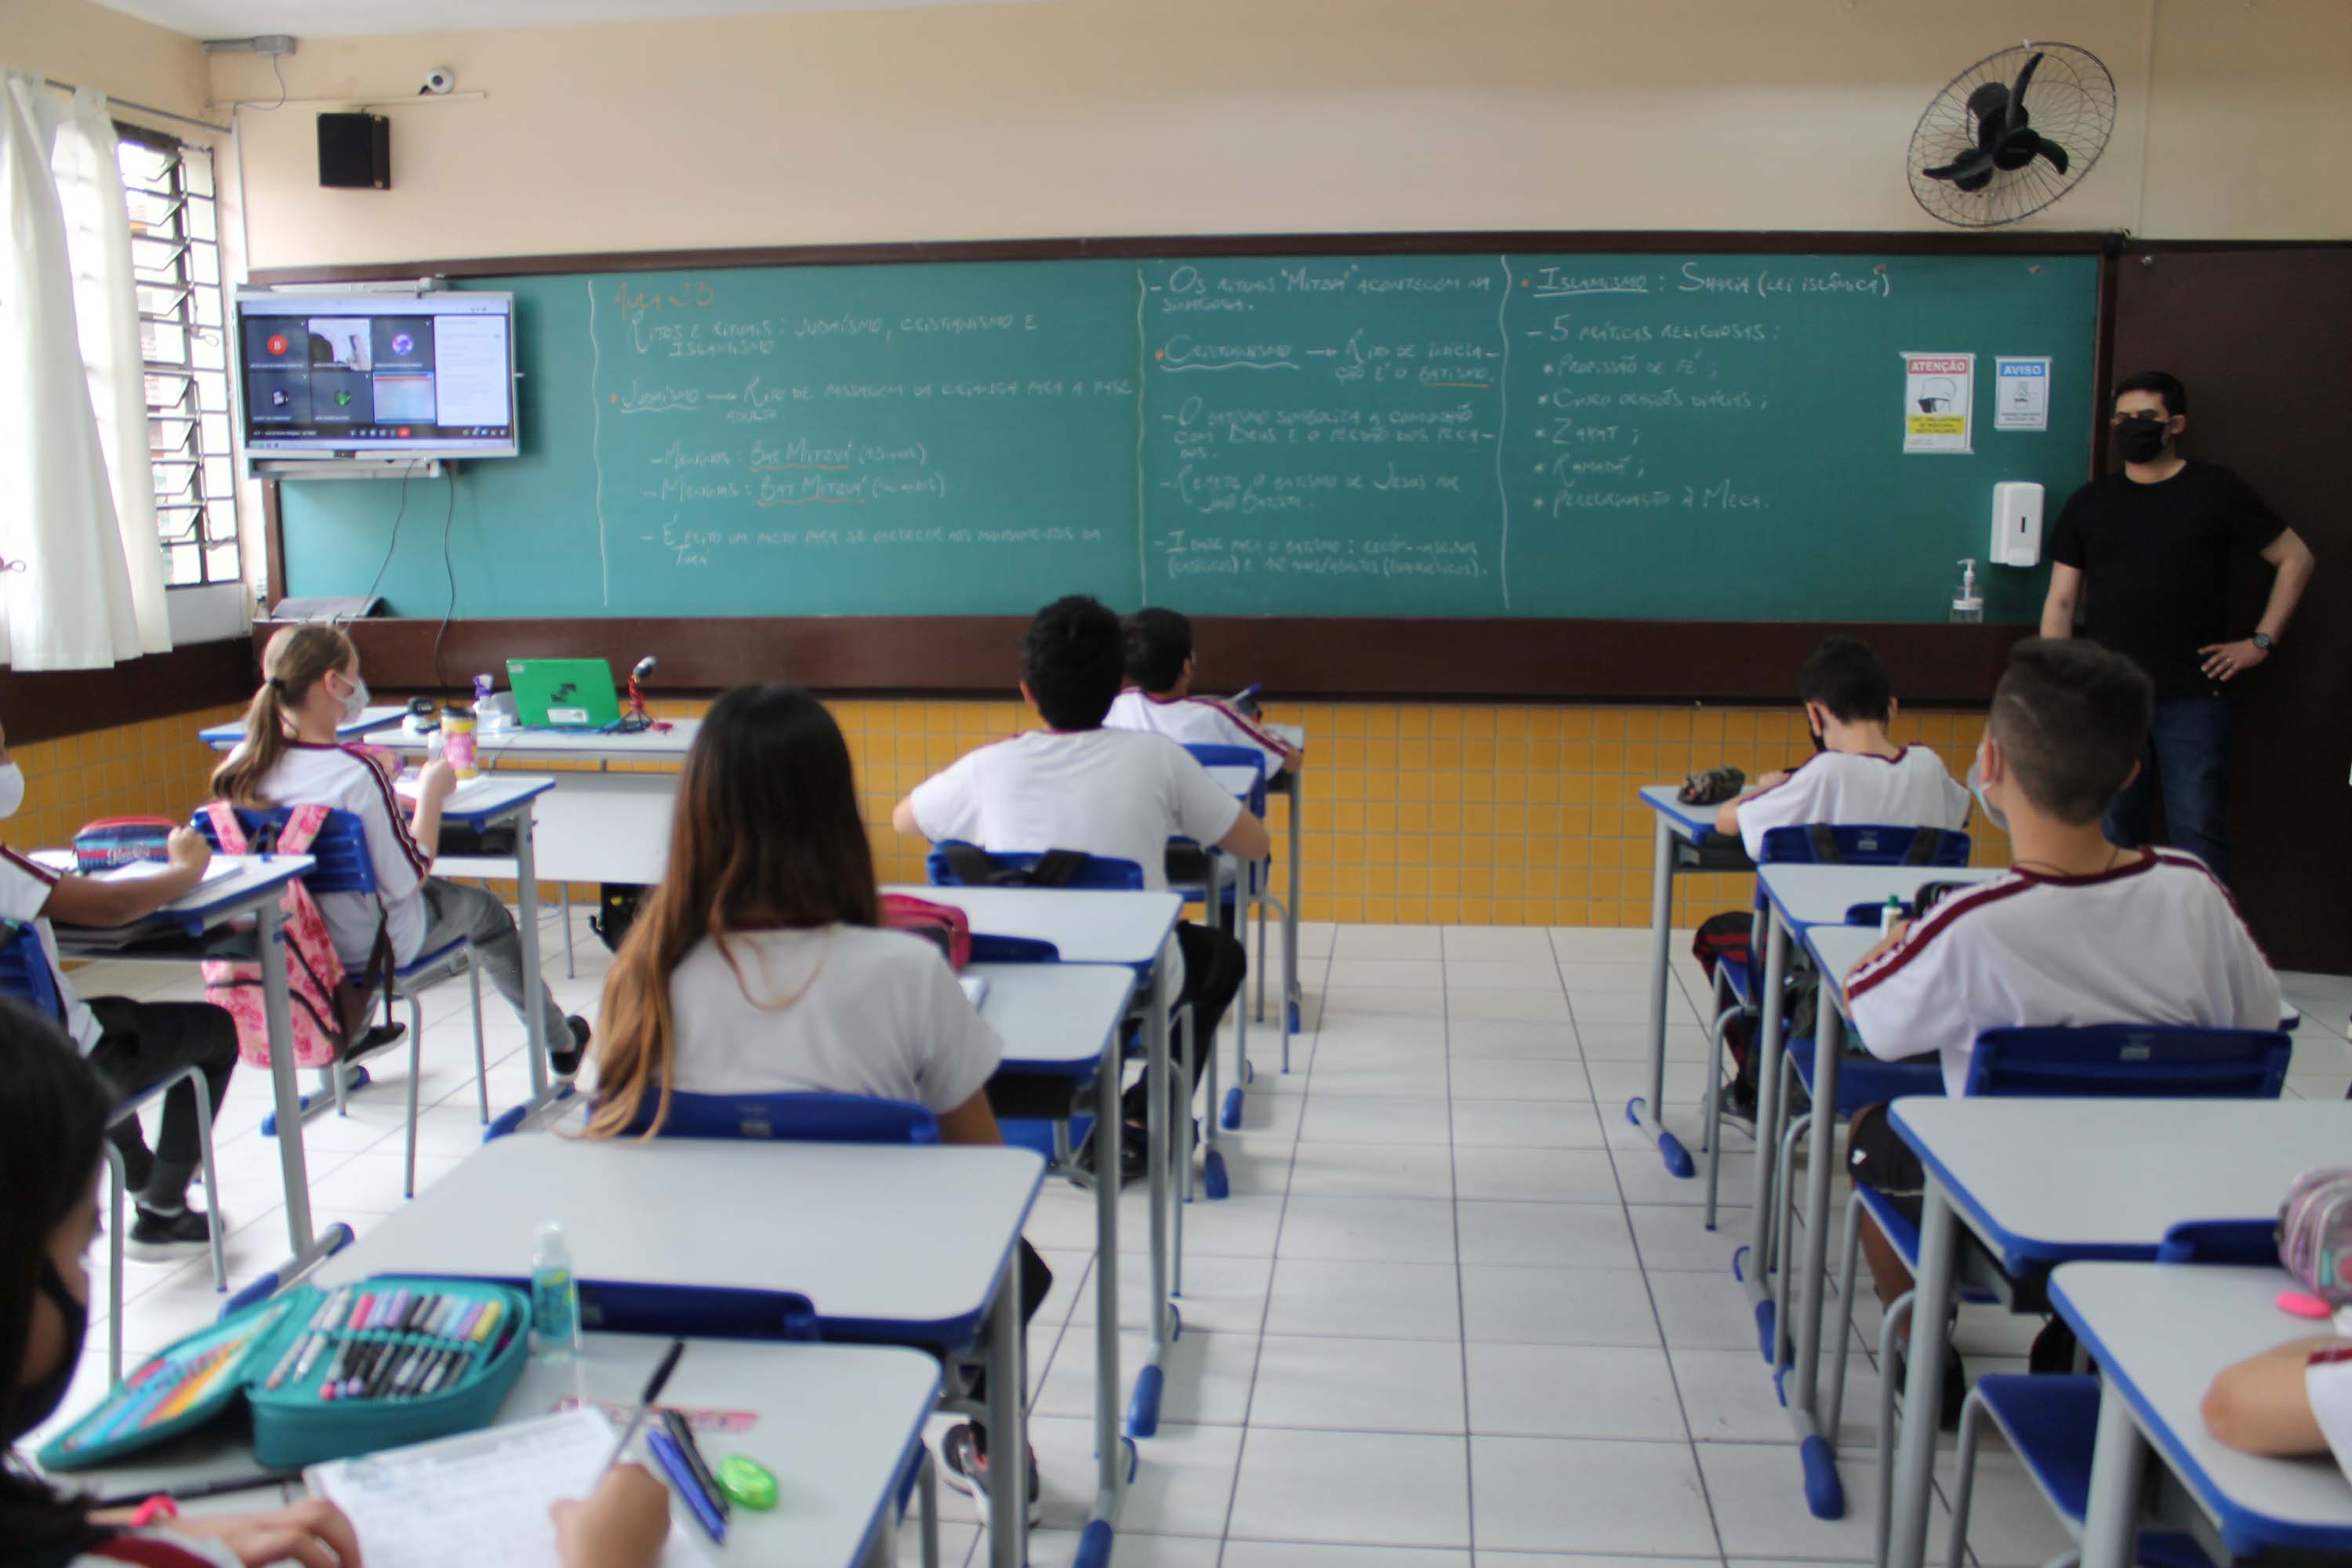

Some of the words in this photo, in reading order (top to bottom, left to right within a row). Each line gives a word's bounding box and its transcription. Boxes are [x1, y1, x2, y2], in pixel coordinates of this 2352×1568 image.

[1549, 313, 1572, 342] 5
[1911, 361, 1965, 374] ATENÇÃO
[2003, 364, 2042, 376] AVISO
